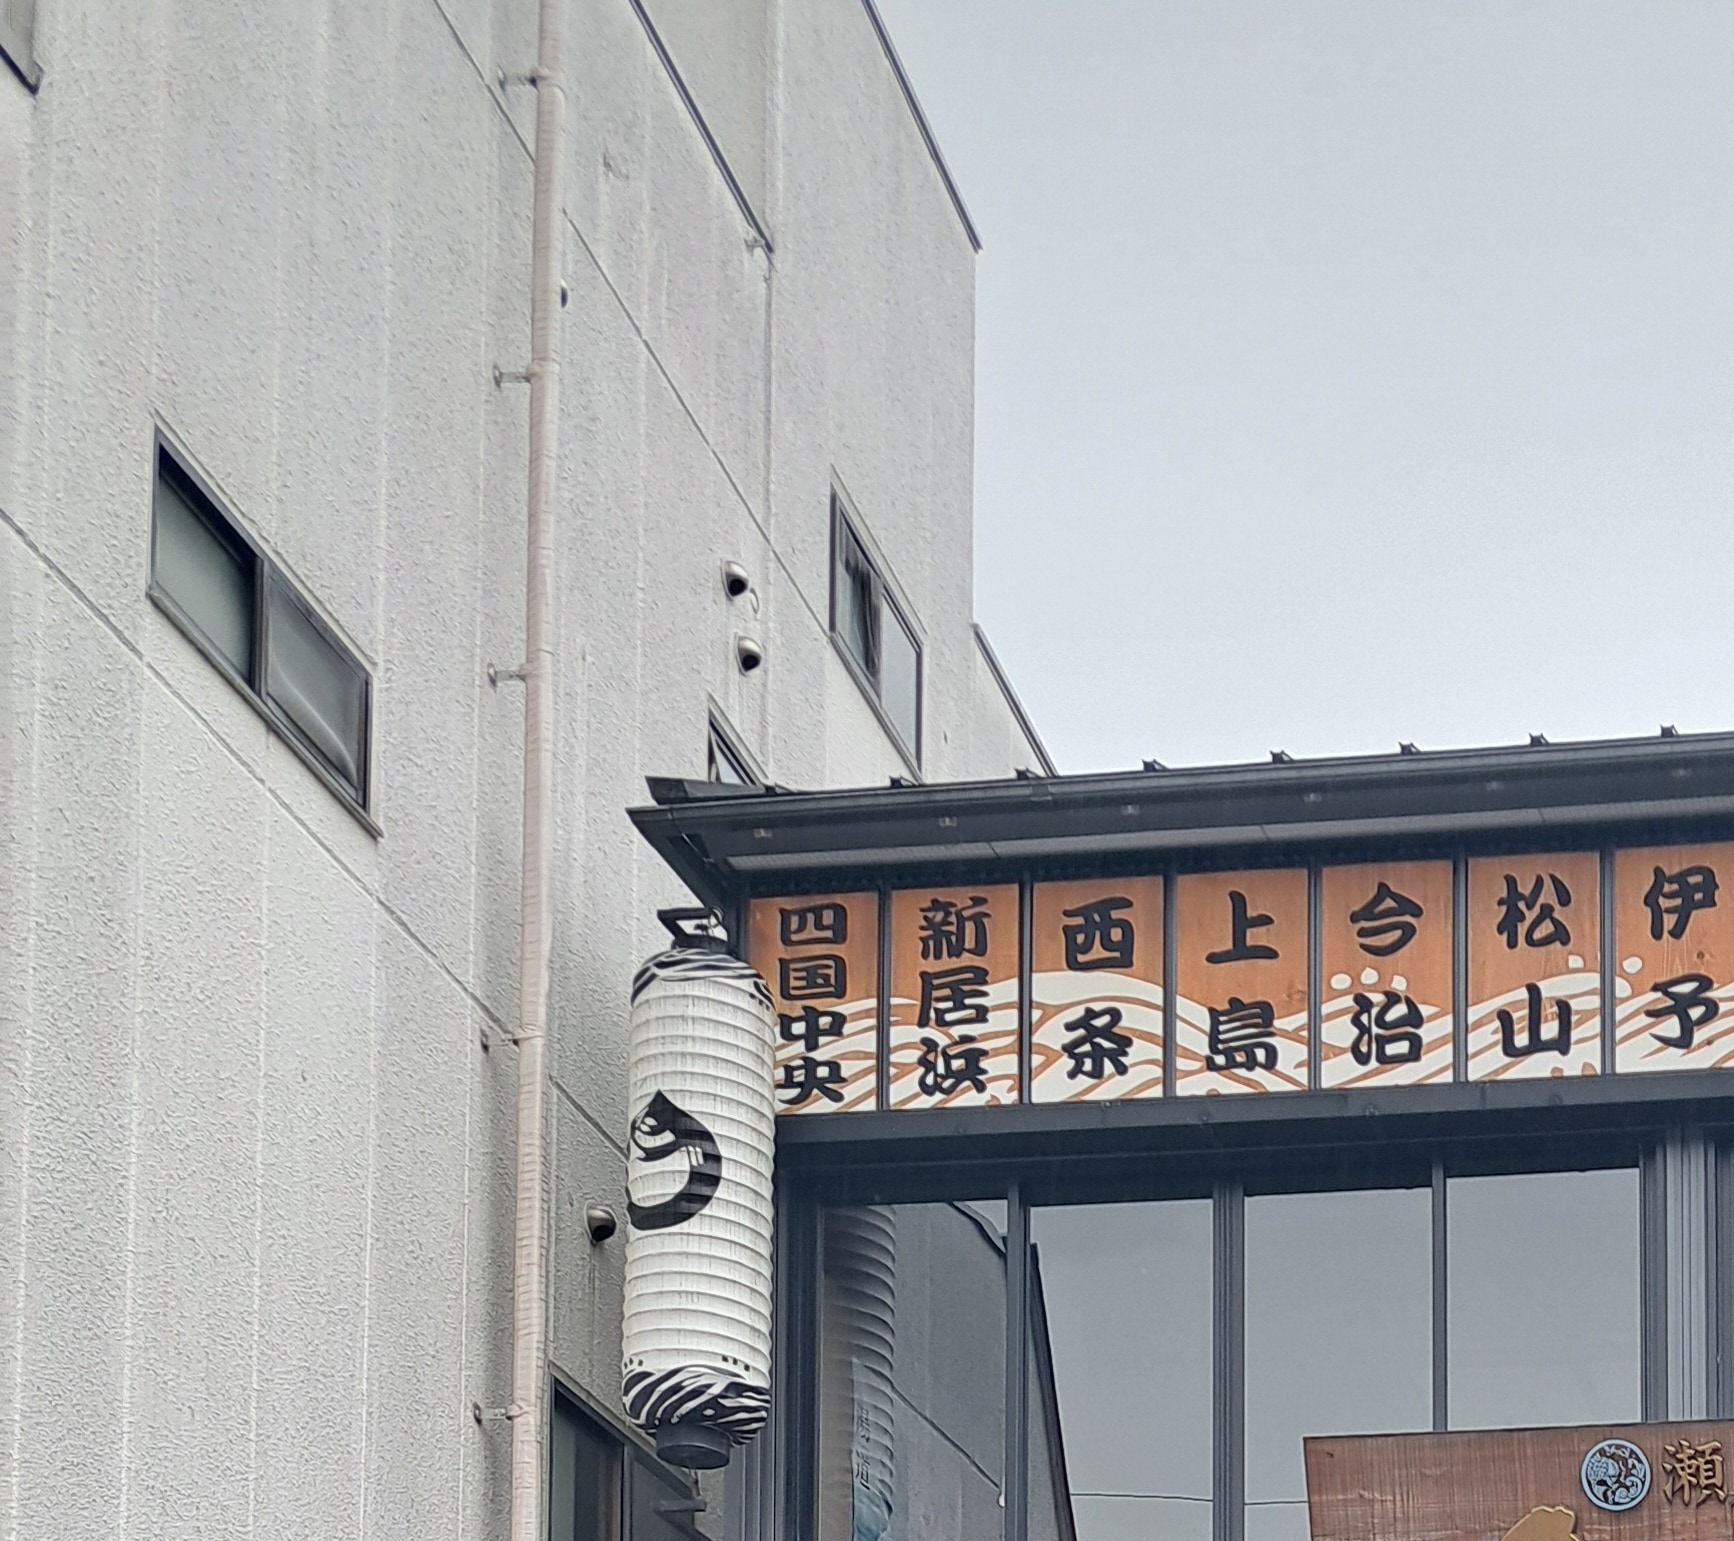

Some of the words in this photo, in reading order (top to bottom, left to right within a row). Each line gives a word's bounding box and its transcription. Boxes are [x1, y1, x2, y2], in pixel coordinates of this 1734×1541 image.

[778, 902, 848, 1106] 四国中央
[917, 895, 992, 1096] 新居浜
[1061, 895, 1135, 1080] 西条
[1204, 890, 1280, 1072] 上島
[1348, 880, 1424, 1066] 今治
[1496, 873, 1572, 1058] 松山
[1643, 865, 1720, 1049] 伊予
